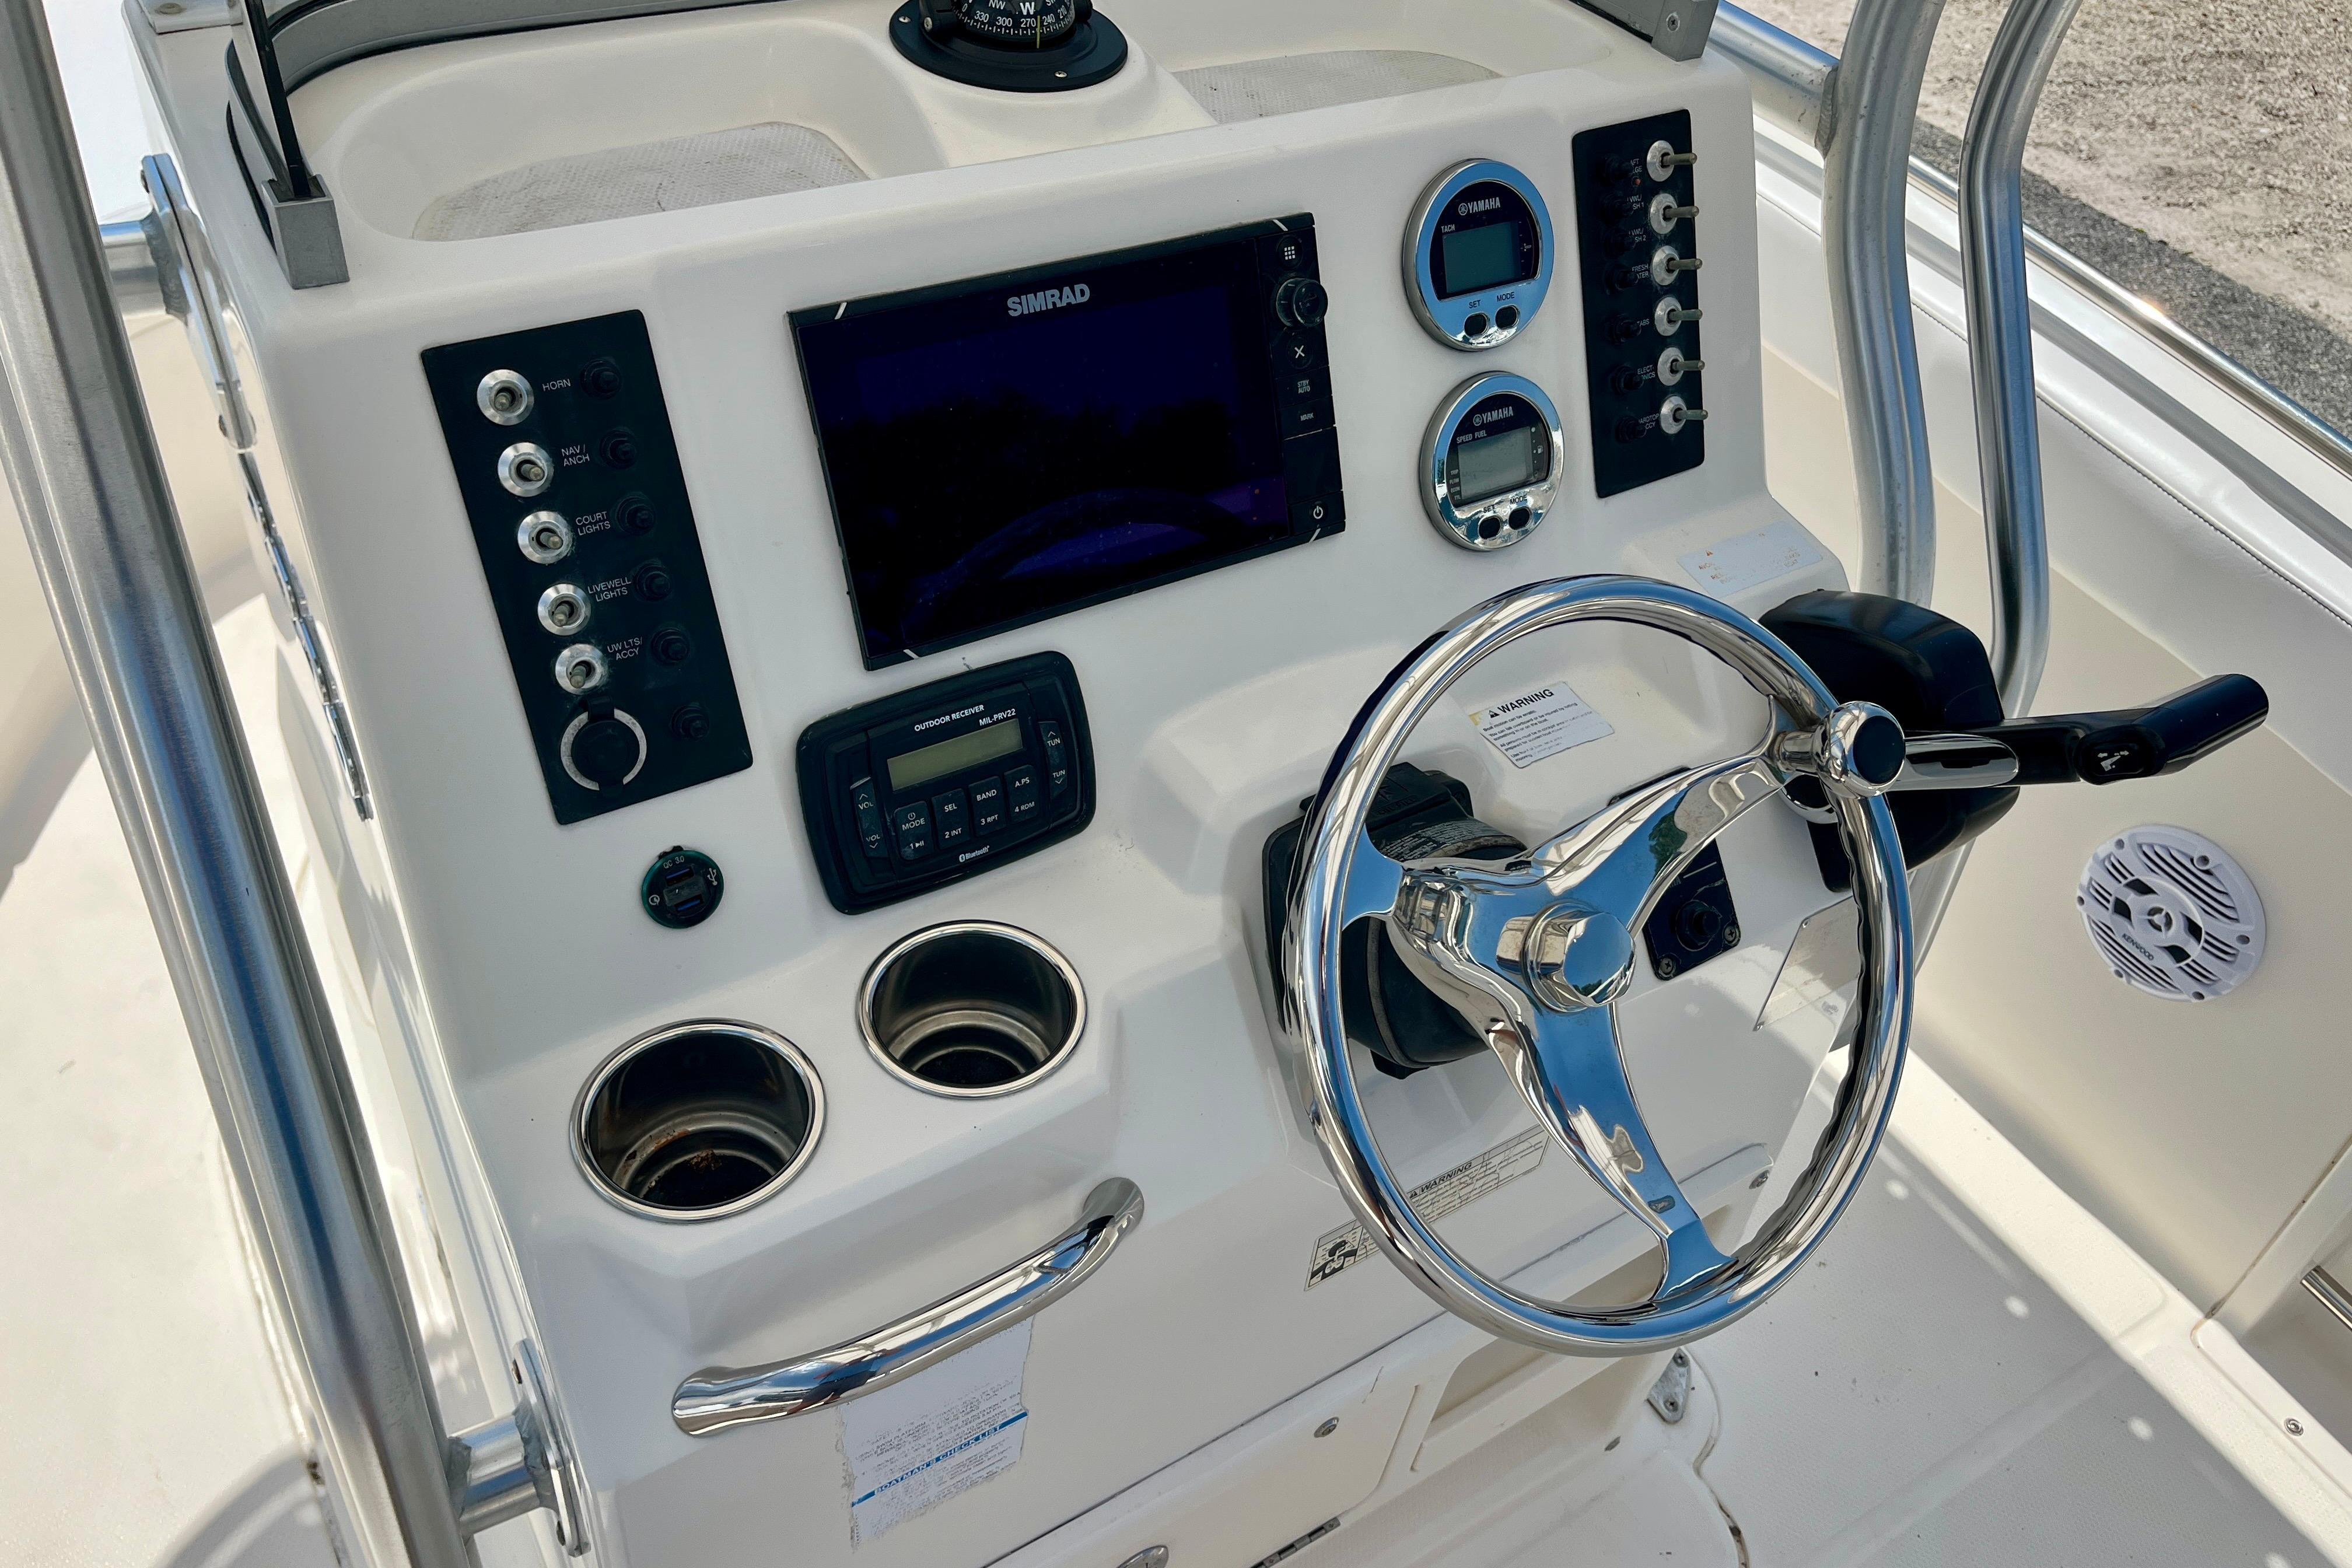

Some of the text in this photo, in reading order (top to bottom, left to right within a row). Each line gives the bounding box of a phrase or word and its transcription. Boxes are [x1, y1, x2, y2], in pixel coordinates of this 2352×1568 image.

[1020, 2, 1035, 15] W
[974, 10, 989, 22] 330
[996, 16, 1012, 26] 300
[1021, 18, 1036, 27] 270
[1042, 13, 1055, 25] 240
[1058, 5, 1067, 19] 210
[1468, 197, 1501, 214] YAMAHA
[1441, 224, 1455, 233] TACH
[1007, 284, 1090, 317] SIMRAD
[1496, 292, 1515, 302] MODE
[1469, 300, 1481, 309] SET
[542, 379, 571, 392] HORN
[1298, 386, 1310, 394] AUTO
[1300, 412, 1314, 421] MARK
[1482, 406, 1513, 424] YAMAHA
[1457, 430, 1487, 443] SPEED FUEL
[564, 453, 590, 467] ANCH
[1510, 494, 1528, 505] MODE
[1483, 504, 1496, 513] SET
[575, 511, 608, 526] COURT
[577, 520, 611, 536] LIGHTS
[587, 576, 631, 594] LIVEWELL
[595, 587, 628, 602] LIGHTS
[607, 642, 622, 653] UW
[615, 648, 639, 660] ACCY
[1497, 689, 1554, 713] WARNING
[914, 704, 985, 732] OUTDOOR RECEIVER
[979, 708, 1016, 726] MIL-PRV22
[1047, 737, 1060, 747] TUN
[1052, 769, 1066, 778] TUN
[1014, 777, 1030, 788] A.PS
[977, 789, 997, 802] BAND
[858, 801, 874, 810] VOL
[944, 803, 957, 812] SEL
[1020, 802, 1035, 811] RDM
[902, 817, 925, 831] MODE
[986, 814, 999, 824] RPT
[866, 834, 880, 842] VOL
[951, 828, 962, 836] INT
[965, 846, 988, 860] Bluetooth
[663, 860, 673, 869] QC
[2122, 933, 2154, 961] KENWOOD
[1421, 1162, 1472, 1192] WARNING
[979, 1424, 1001, 1440] LIST
